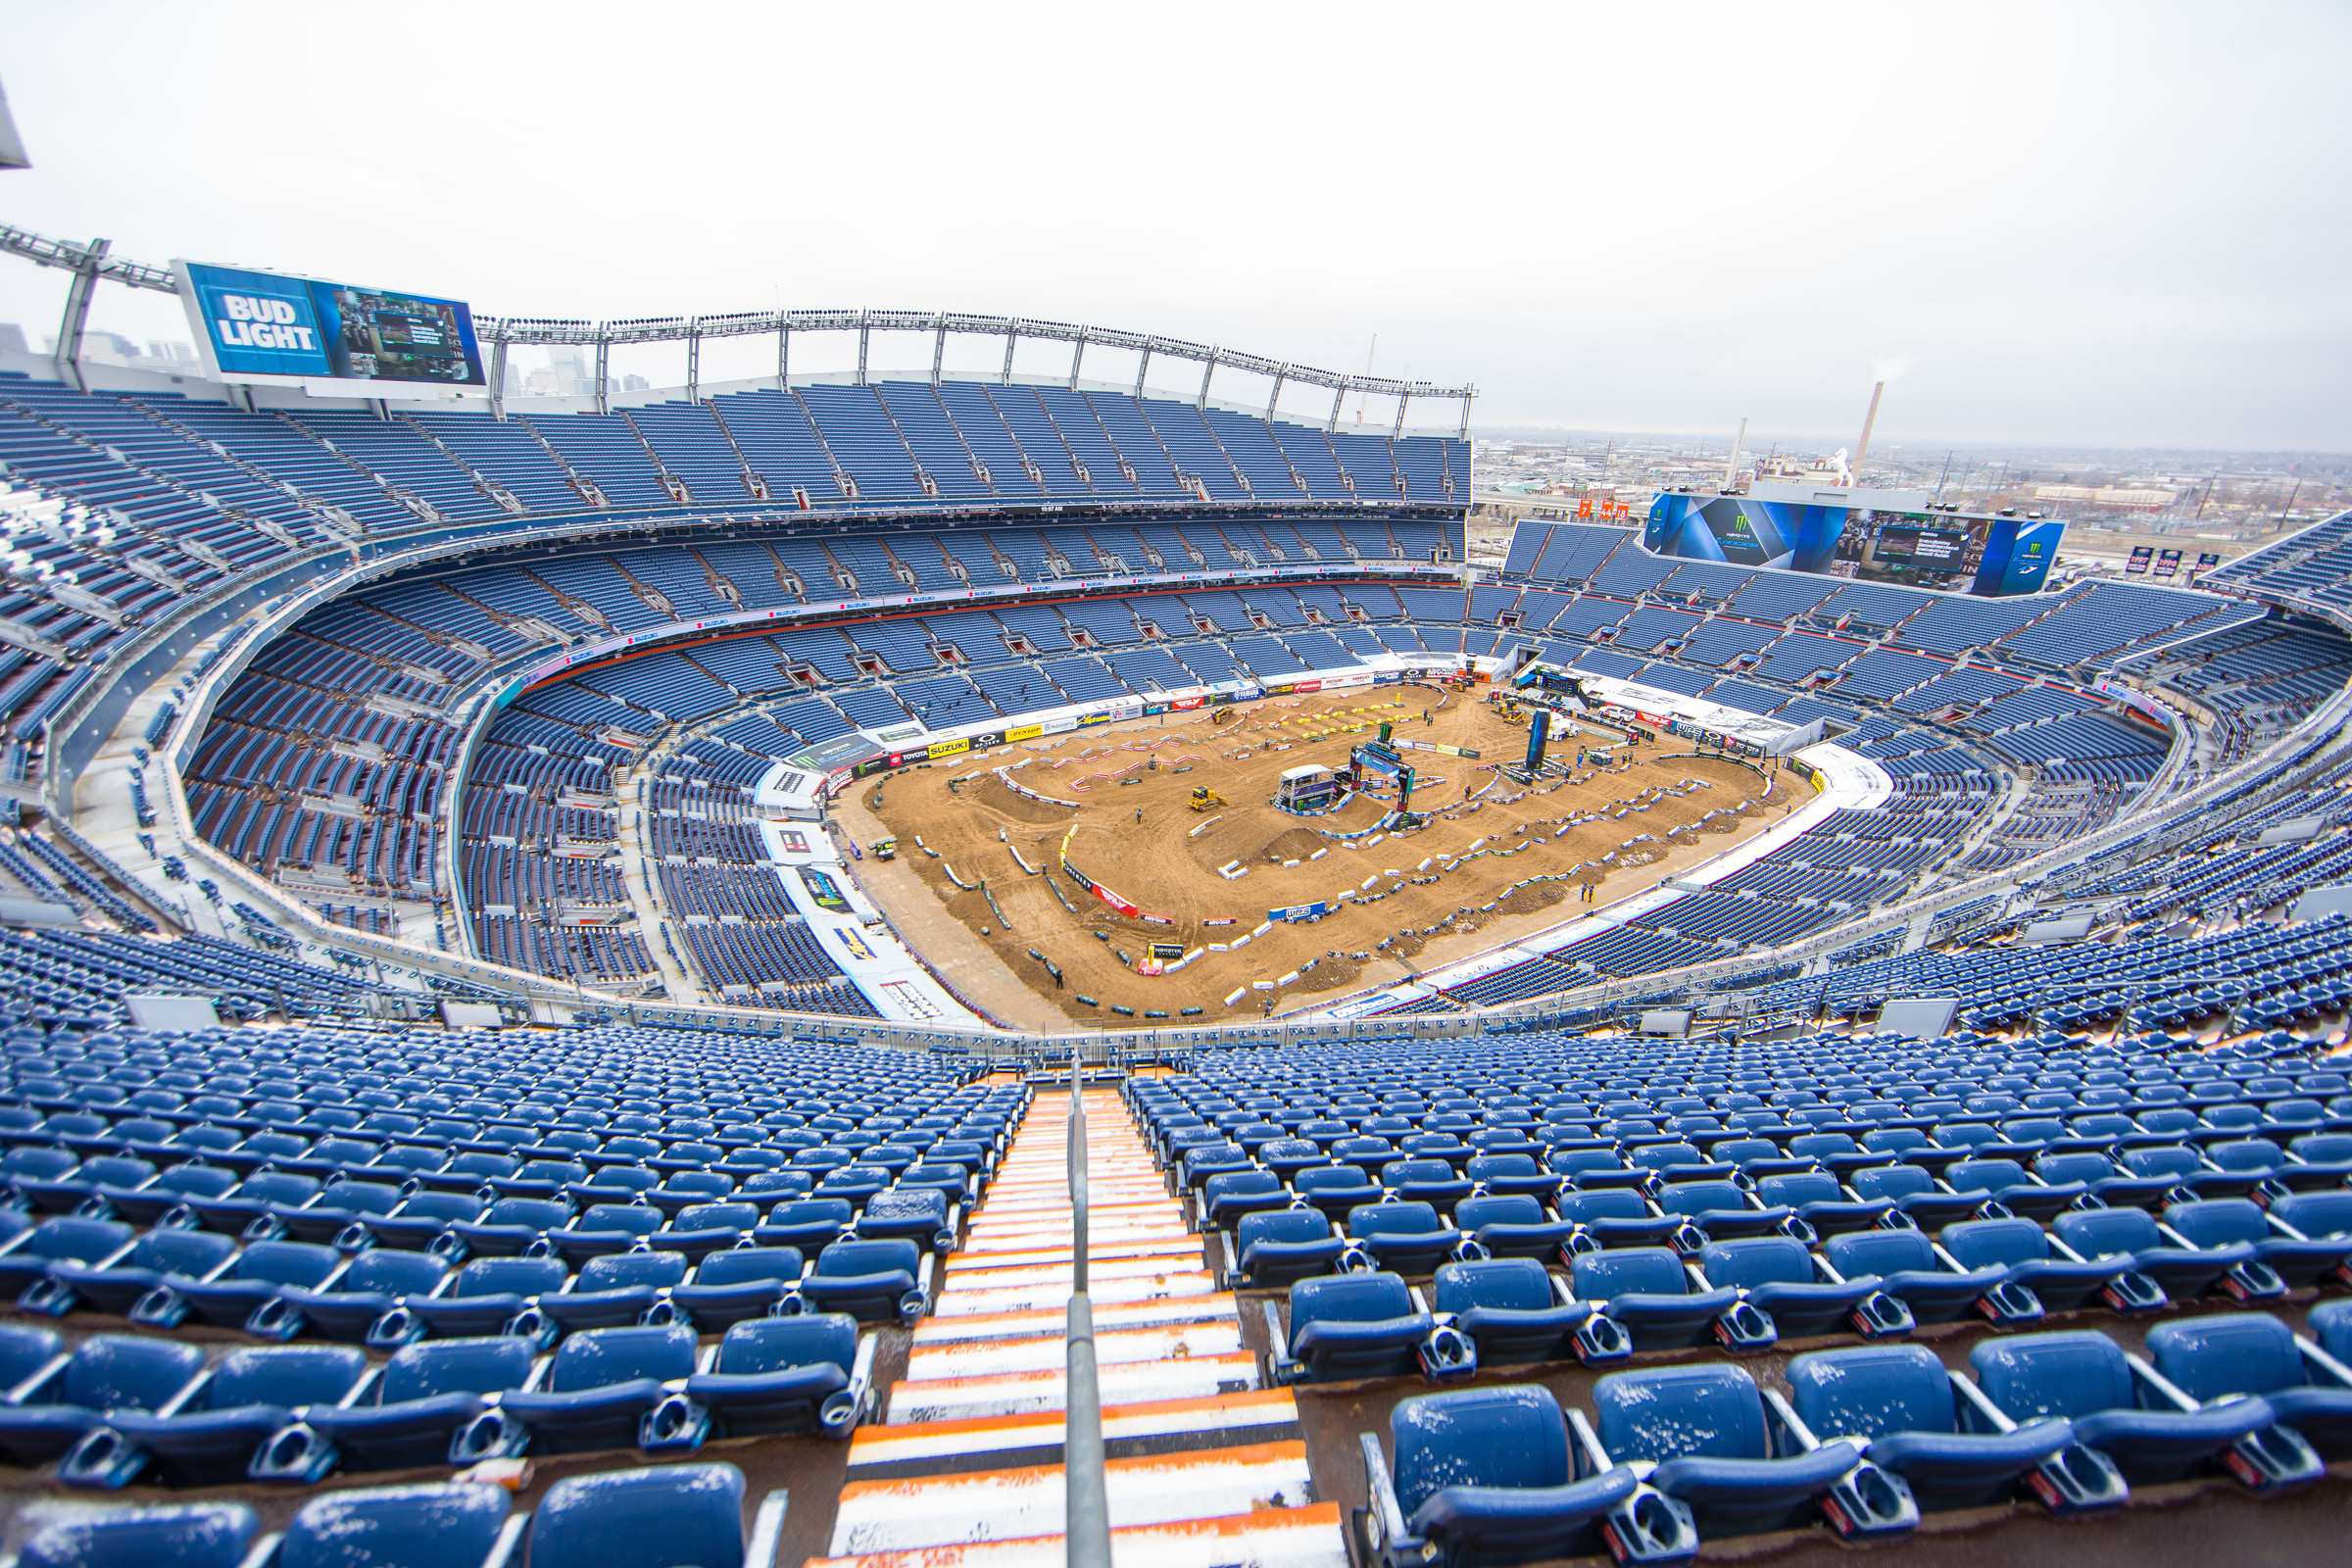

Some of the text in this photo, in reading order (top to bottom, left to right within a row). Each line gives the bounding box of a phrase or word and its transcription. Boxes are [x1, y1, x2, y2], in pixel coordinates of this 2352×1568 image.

[224, 295, 296, 324] BUD
[219, 320, 316, 351] LIGHT
[776, 609, 801, 617] SUZUKI
[703, 618, 728, 628] SUZUKI
[634, 632, 659, 643] SUZUKI
[571, 651, 594, 662] SUZUKI
[1013, 727, 1041, 737] DUNLOP
[930, 741, 968, 756] SUZUKI
[903, 751, 928, 760] TOYOTA
[1286, 906, 1311, 919] WPS
